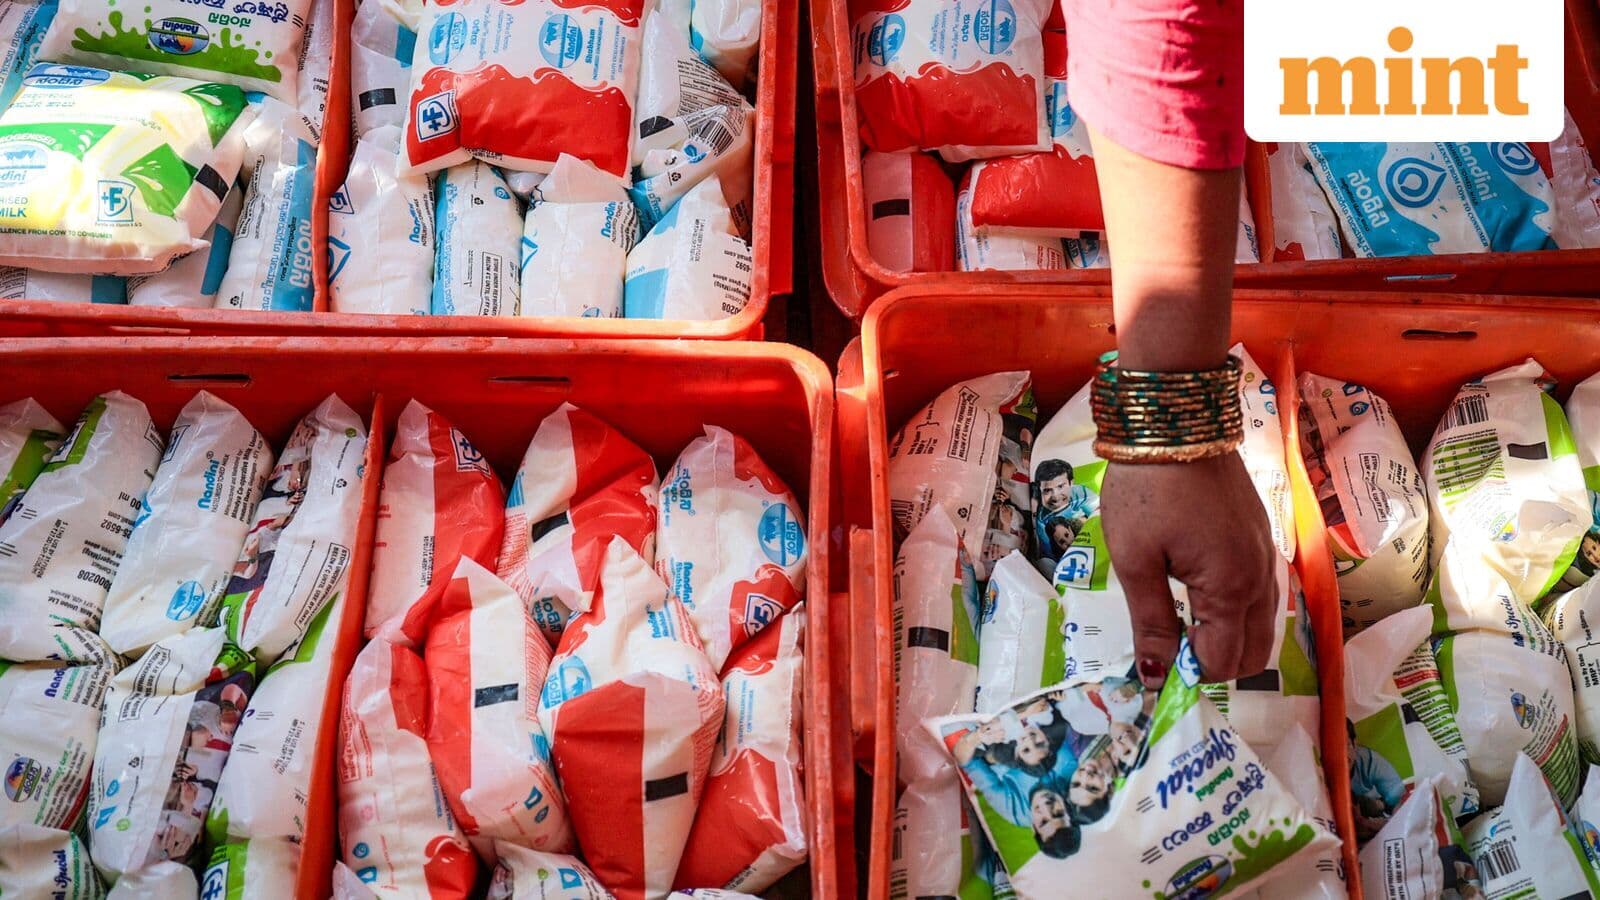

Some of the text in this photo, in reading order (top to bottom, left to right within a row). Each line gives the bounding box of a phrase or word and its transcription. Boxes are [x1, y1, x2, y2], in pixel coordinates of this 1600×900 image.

[162, 20, 199, 34] Nandini
[208, 12, 252, 28] ನಂದಿನಿ
[564, 26, 578, 60] Nandini
[585, 29, 596, 64] Shubham
[1347, 170, 1389, 228] ನಂದಿನಿ
[1466, 211, 1489, 248] CONSUMER
[290, 218, 312, 289] ನಂದಿನಿ
[197, 459, 220, 510] Nandini
[230, 496, 242, 519] Mandya
[787, 521, 797, 555] ನಂದಿನಿ
[91, 561, 112, 574] Contact
[1157, 728, 1235, 809] Special
[1196, 767, 1233, 801] Nandini
[1162, 811, 1214, 851] ಹಾಲು
[1207, 807, 1251, 846] ನಂದಿನಿ
[1172, 859, 1213, 891] Nandini
